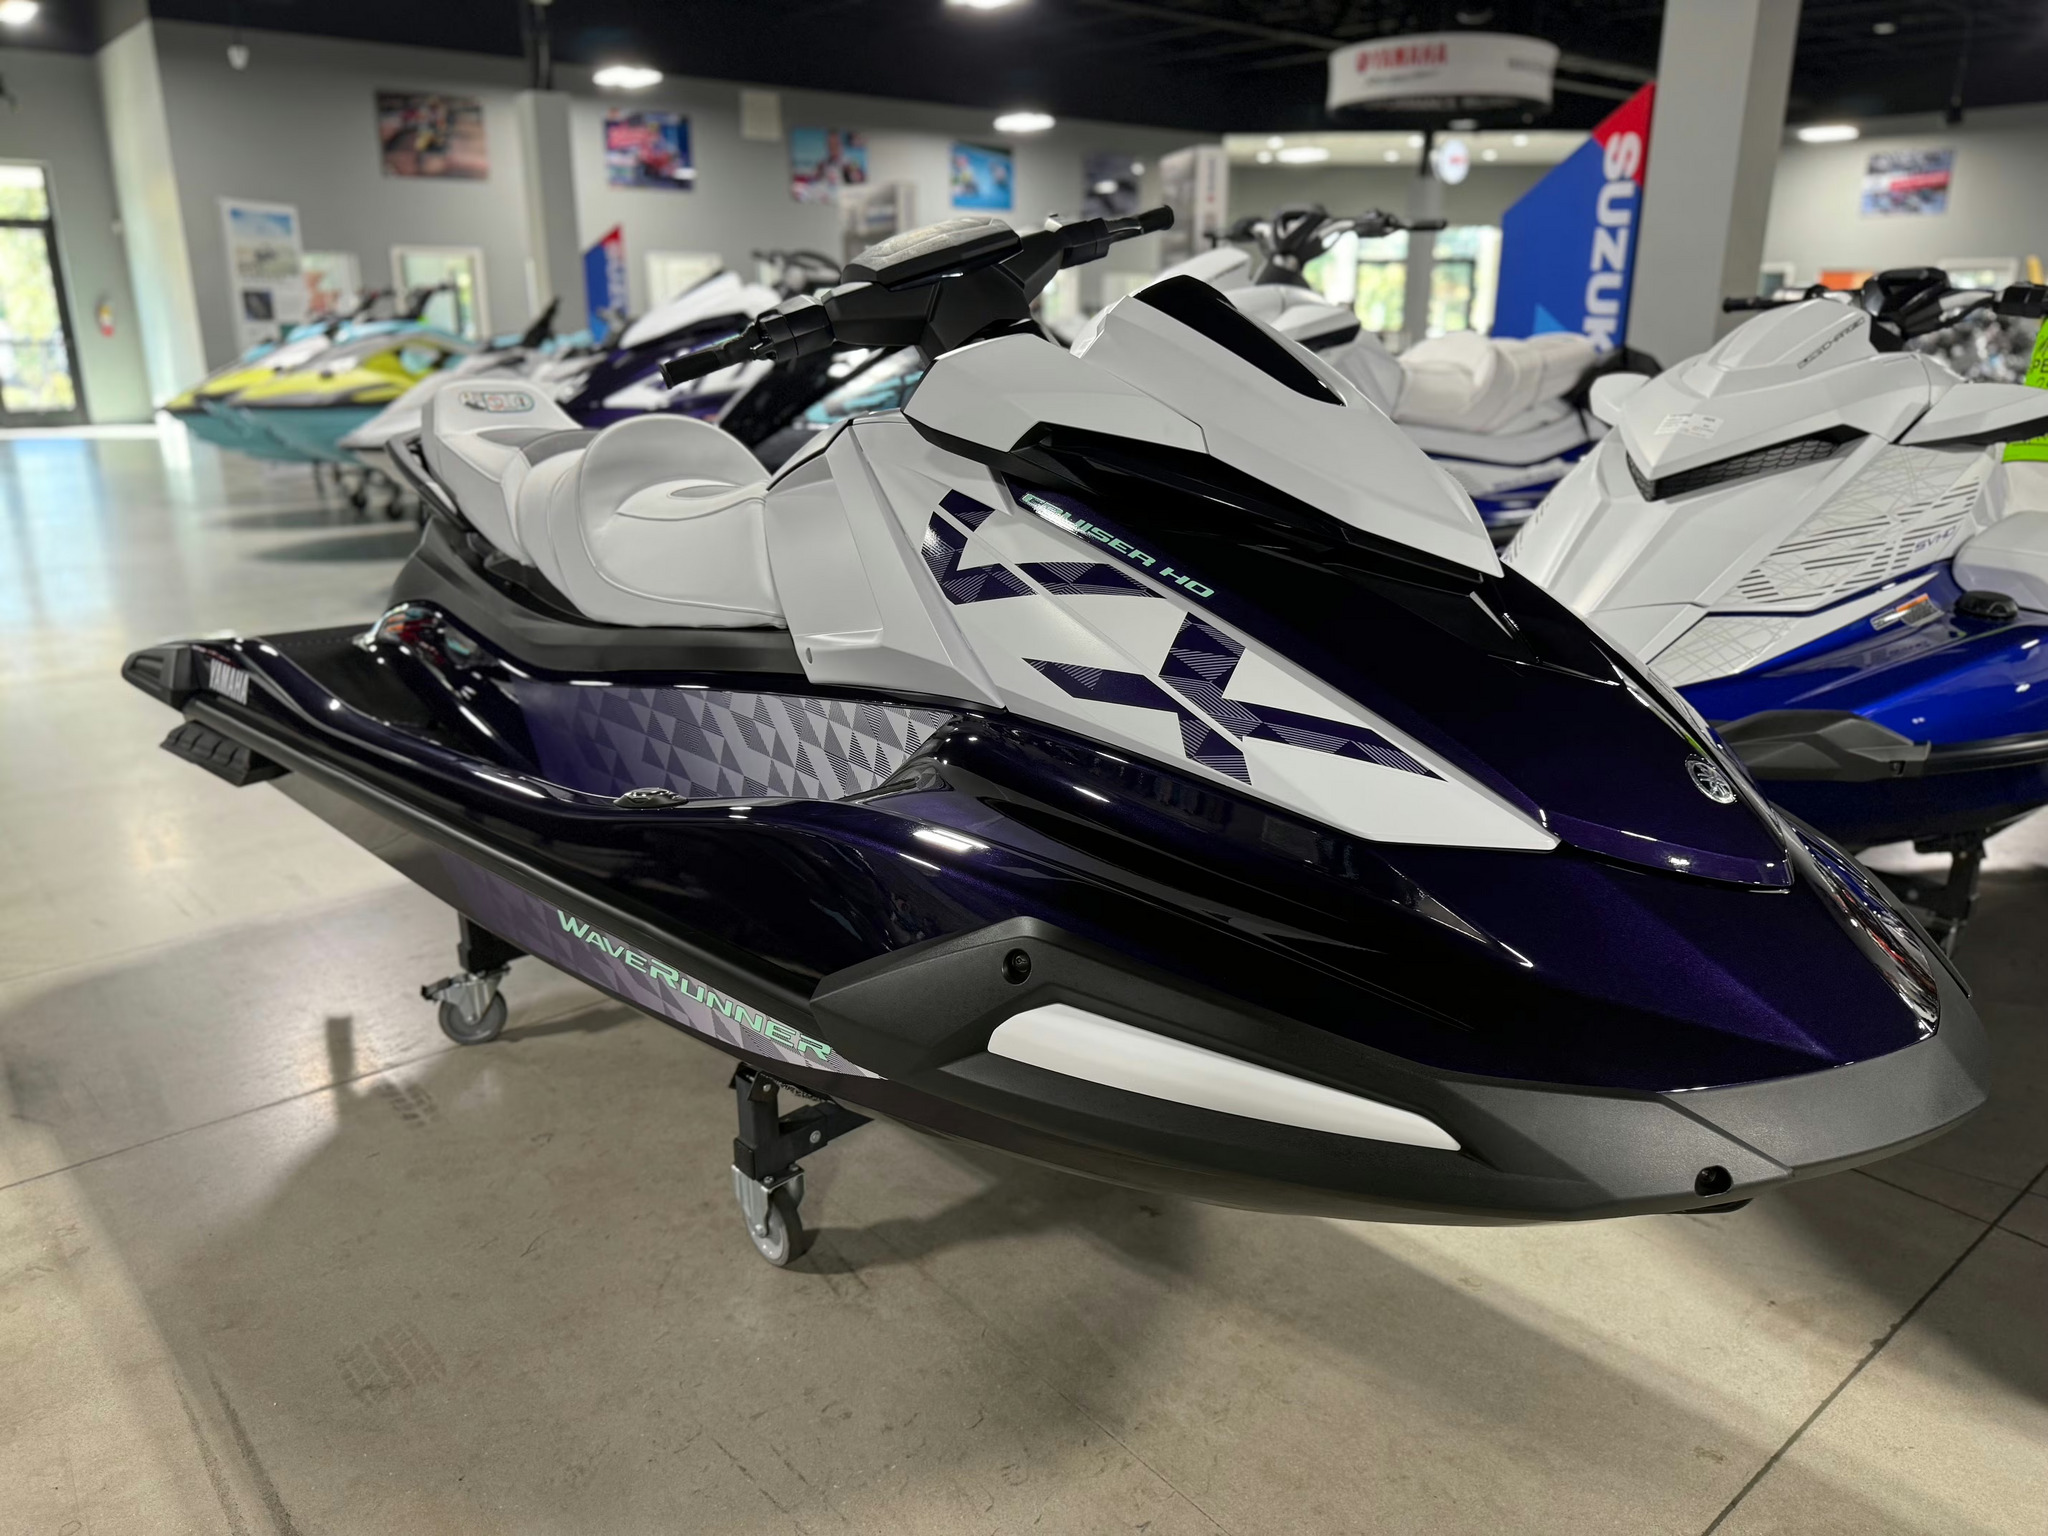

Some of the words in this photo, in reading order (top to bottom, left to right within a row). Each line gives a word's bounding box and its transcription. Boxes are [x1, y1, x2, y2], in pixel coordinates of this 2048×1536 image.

[1582, 131, 1642, 354] SUZUK
[1021, 493, 1156, 568] CRUISER
[1159, 567, 1215, 598] HO
[209, 658, 249, 706] YAMAHA
[557, 909, 832, 1060] WAVERUNNER
